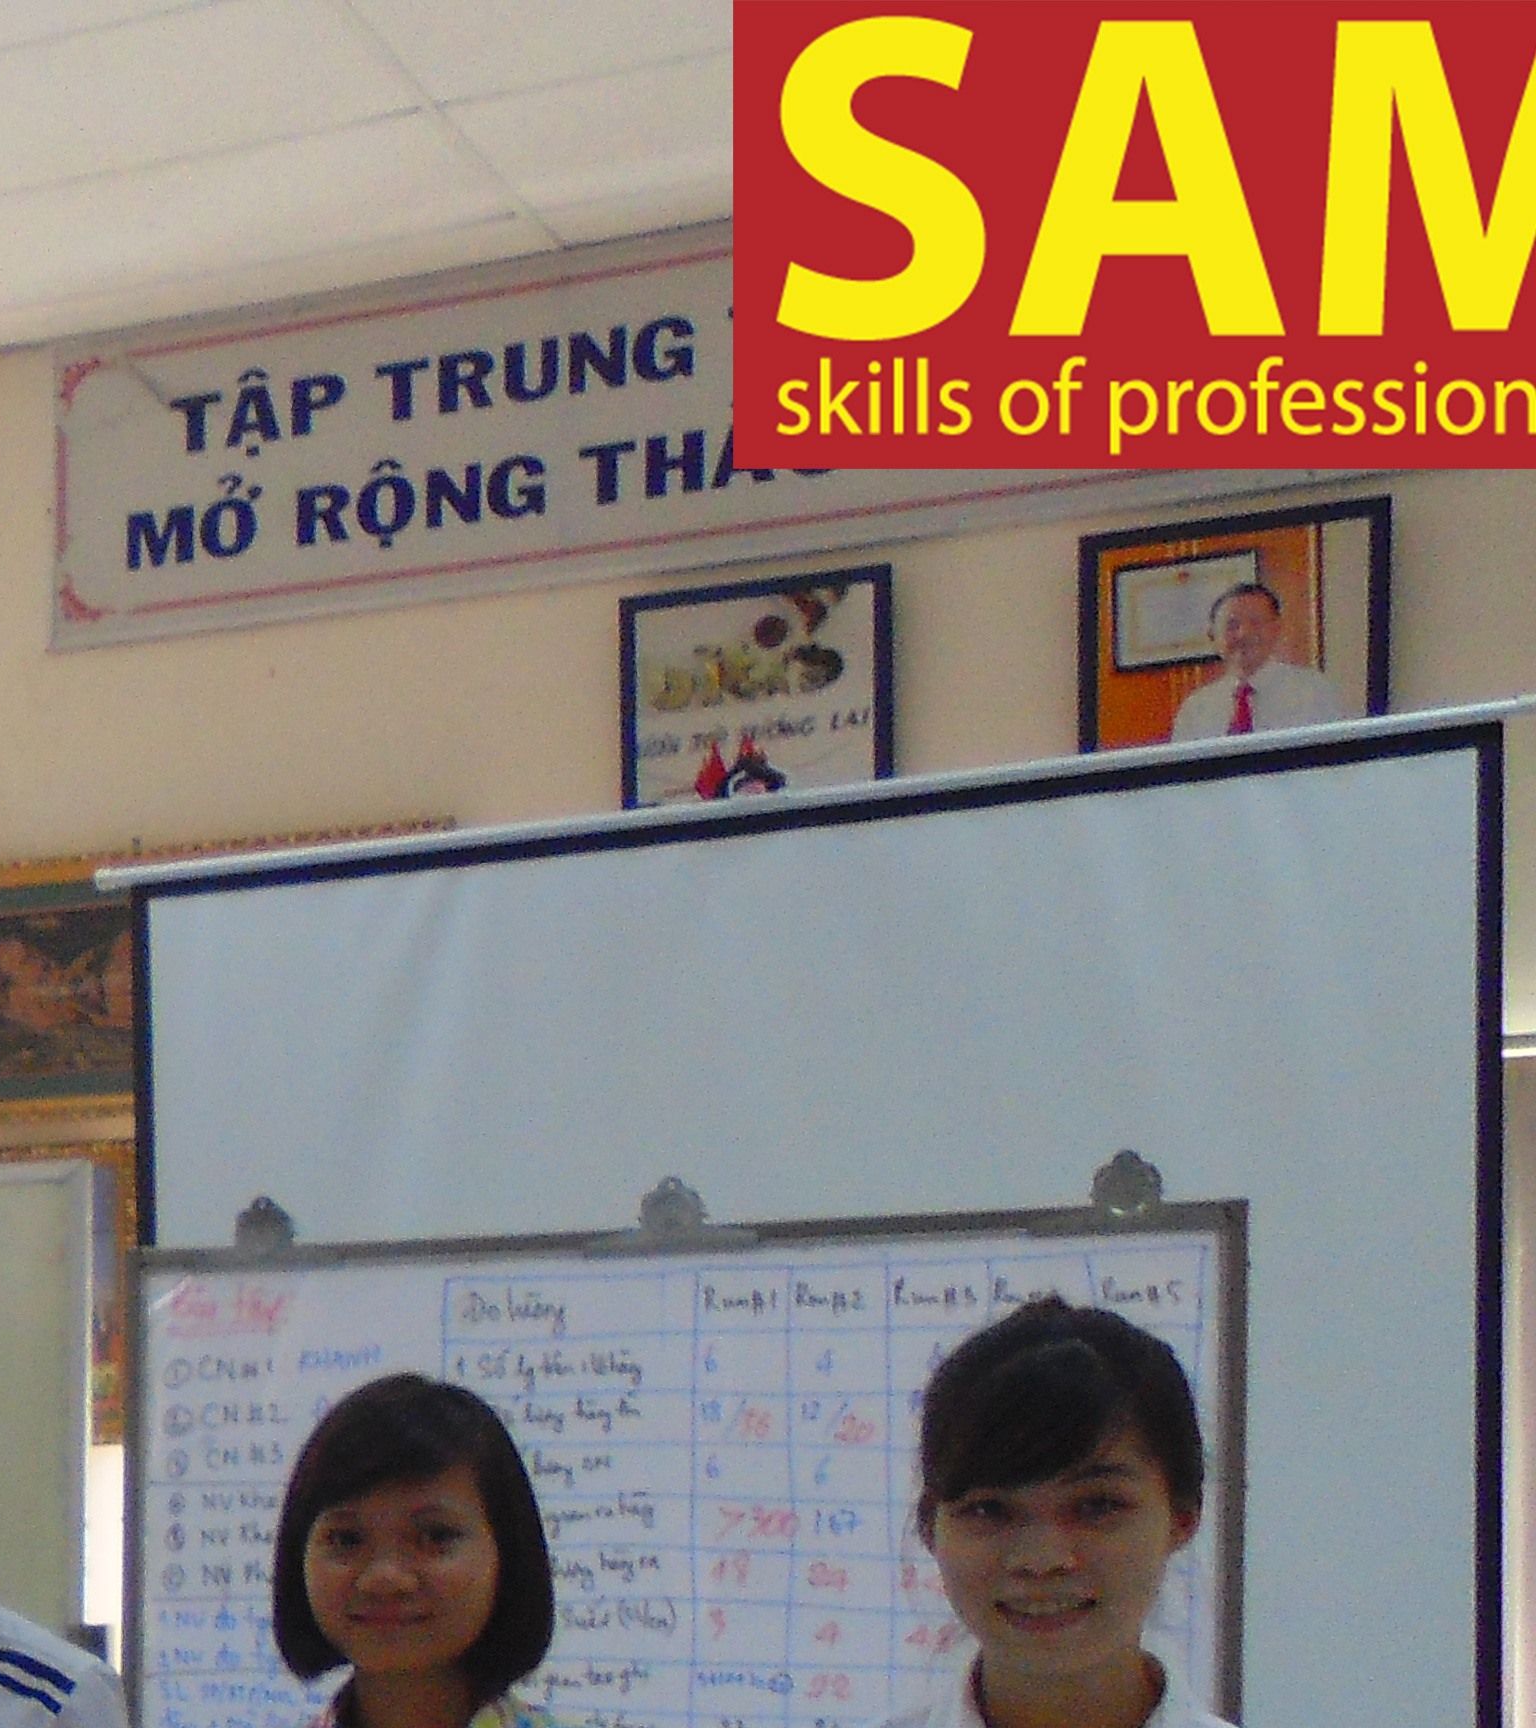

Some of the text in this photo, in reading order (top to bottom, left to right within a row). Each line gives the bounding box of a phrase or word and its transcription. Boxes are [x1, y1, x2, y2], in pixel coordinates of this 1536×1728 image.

[170, 314, 696, 457] TẬP TRUNG
[127, 424, 838, 572] MỞ RỘNG TH
